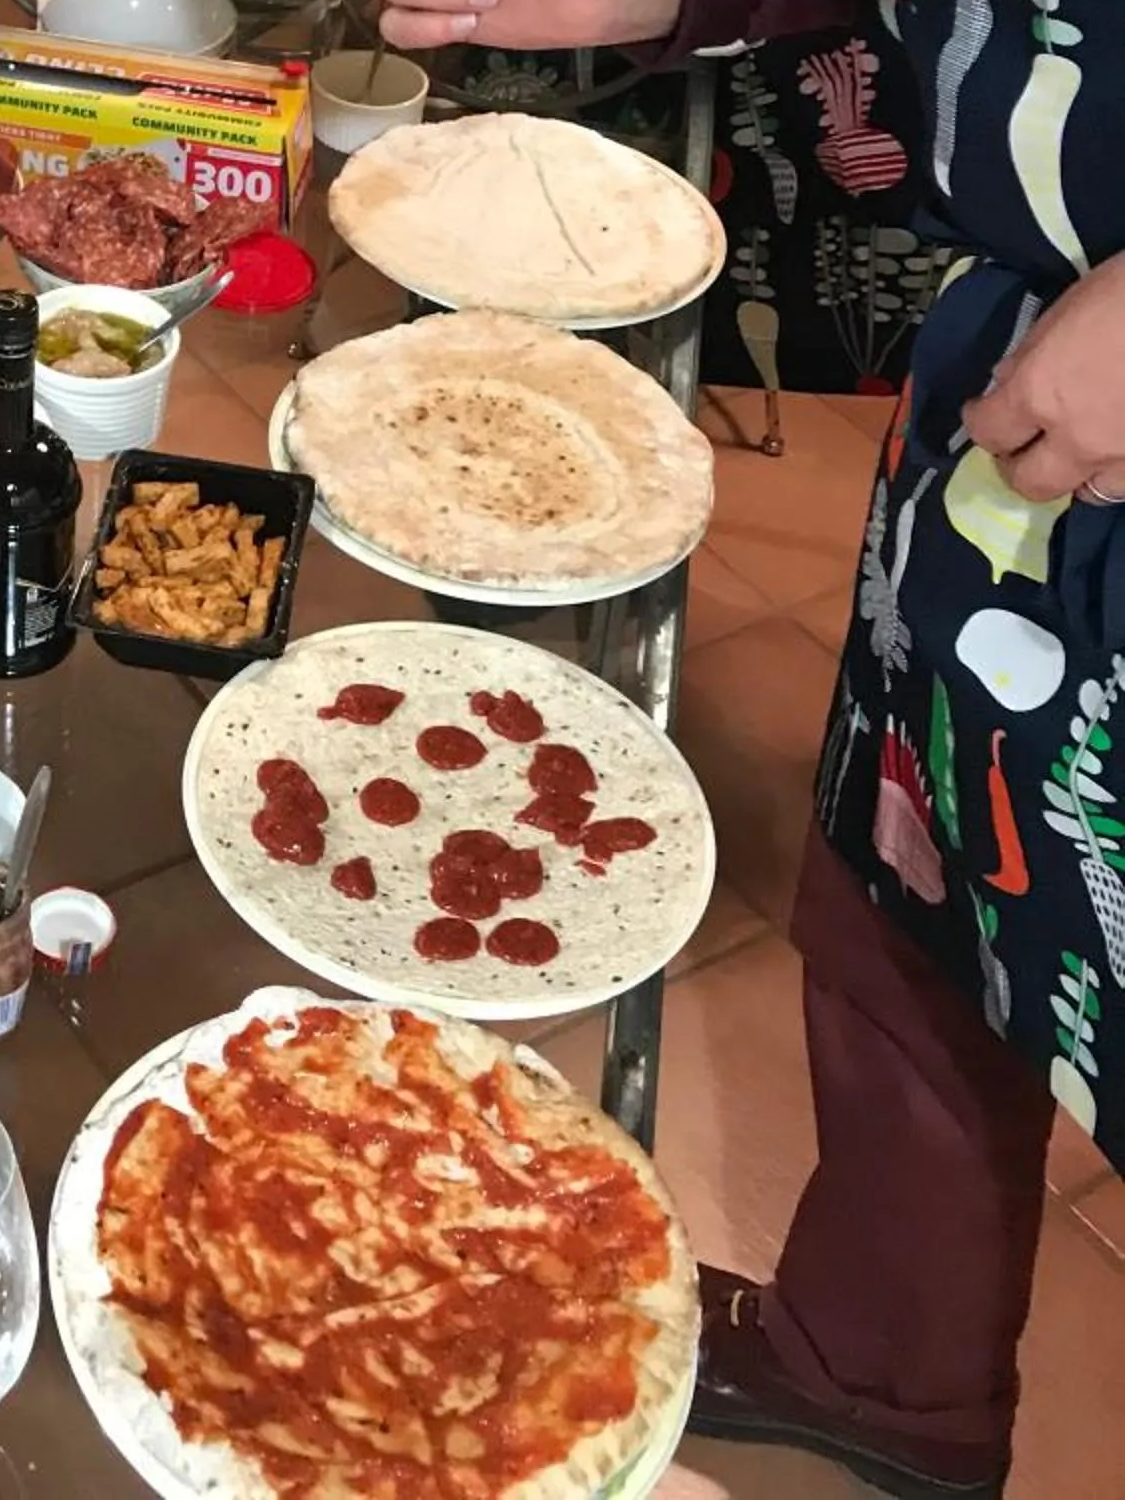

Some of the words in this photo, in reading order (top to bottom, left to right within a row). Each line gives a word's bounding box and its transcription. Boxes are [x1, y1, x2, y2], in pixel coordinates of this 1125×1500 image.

[62, 105, 98, 120] PACK
[132, 116, 217, 139] COMMUNITY
[219, 131, 258, 146] PACK
[192, 161, 273, 203] 300
